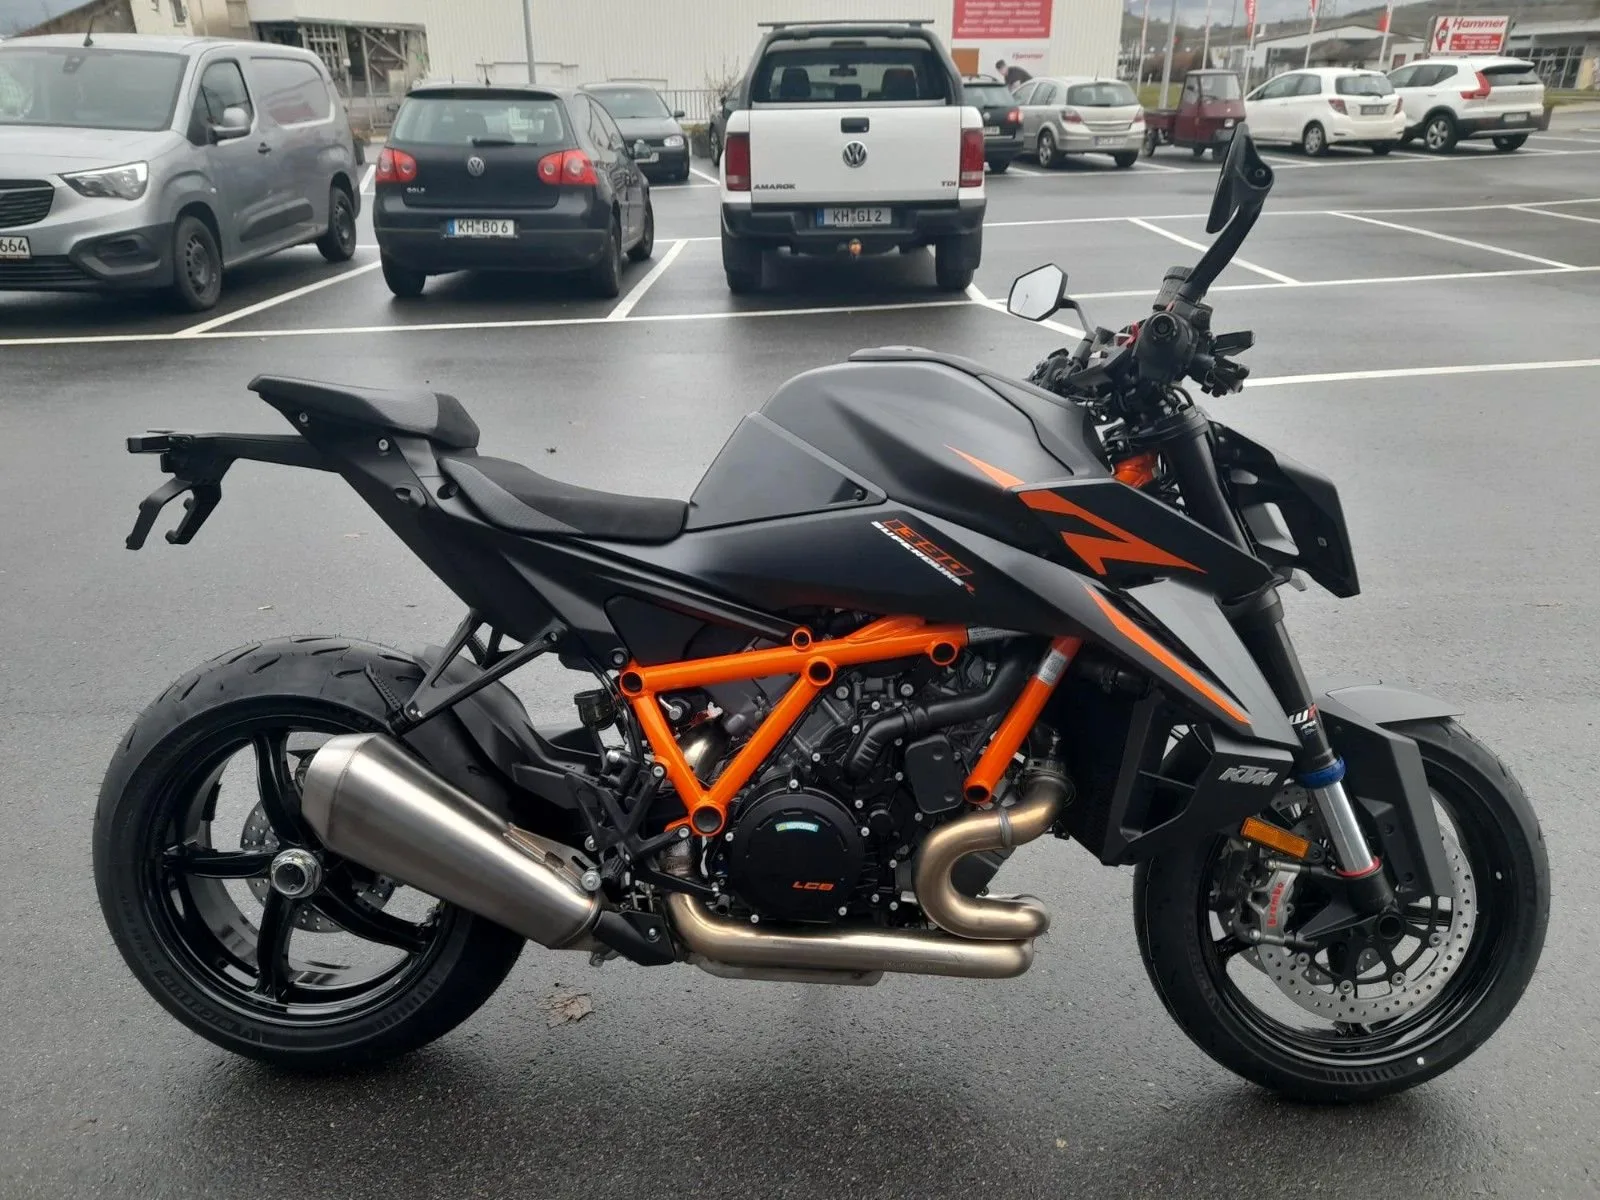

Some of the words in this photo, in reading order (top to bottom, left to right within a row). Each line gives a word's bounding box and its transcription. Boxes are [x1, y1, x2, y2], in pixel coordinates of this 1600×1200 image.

[1453, 17, 1506, 30] Hammer
[833, 209, 850, 223] KH
[457, 220, 475, 233] KH
[1218, 765, 1278, 786] KTM
[1267, 881, 1285, 927] brembo
